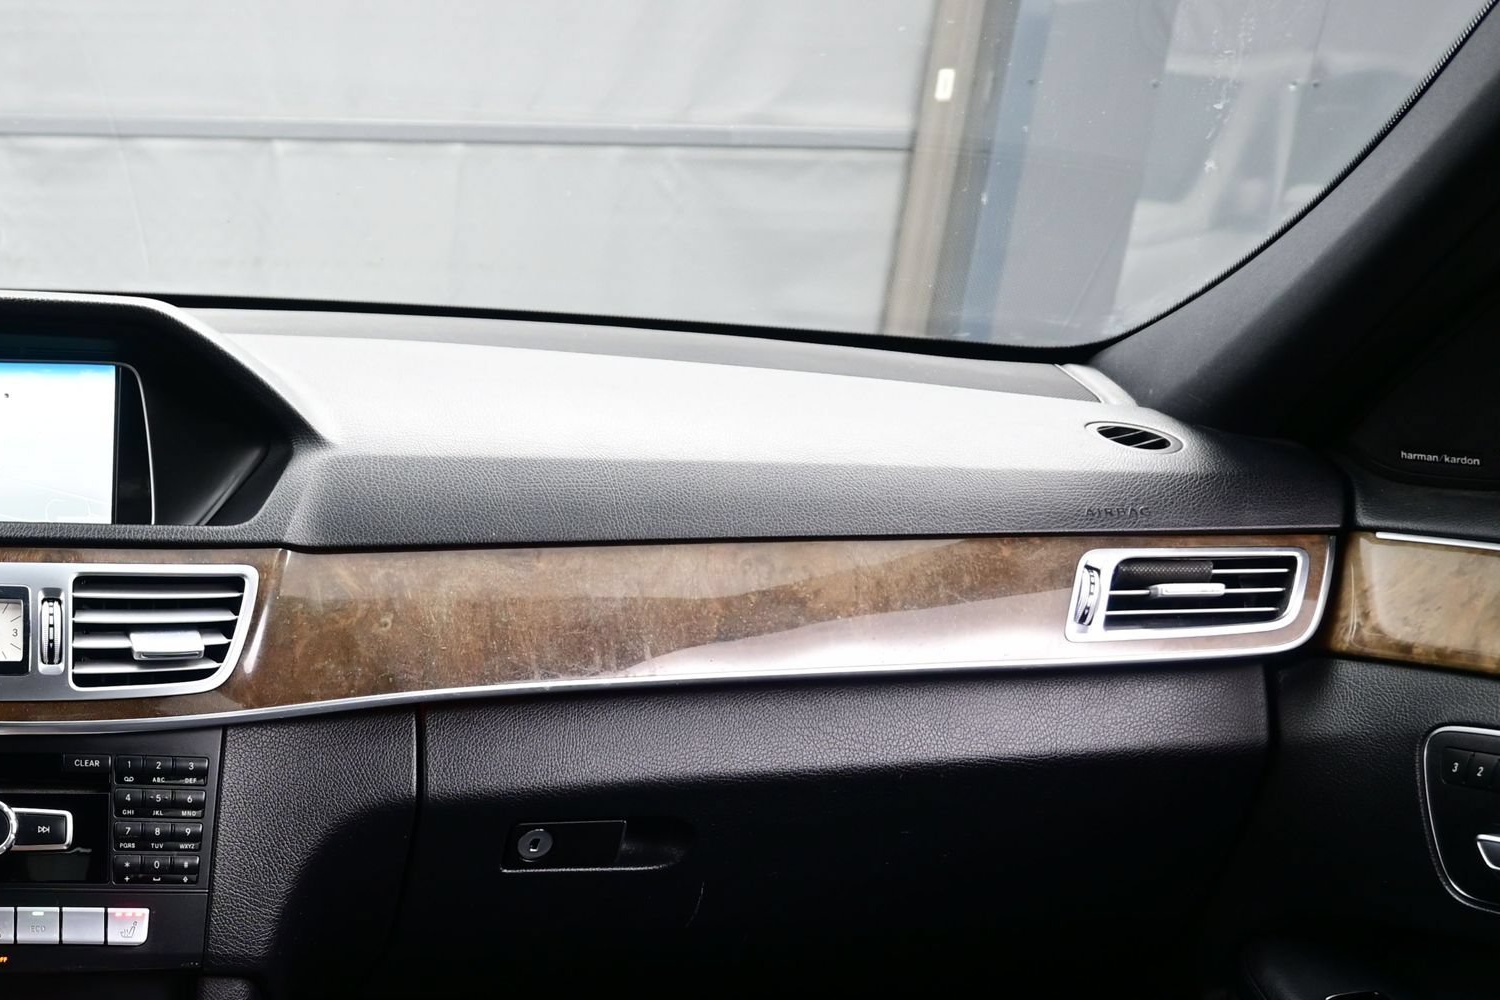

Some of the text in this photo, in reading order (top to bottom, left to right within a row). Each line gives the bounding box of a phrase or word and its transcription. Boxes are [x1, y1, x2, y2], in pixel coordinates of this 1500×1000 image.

[1401, 451, 1480, 465] harman/kardon
[12, 628, 18, 637] 3
[74, 759, 100, 767] CLEAR
[156, 762, 162, 770] 2
[188, 762, 194, 770] 3
[1452, 762, 1459, 773] 3
[1476, 766, 1484, 777] 2
[125, 793, 131, 802] 4
[156, 794, 161, 803] 5
[187, 795, 193, 803] 6
[125, 827, 131, 835] 7
[154, 827, 160, 836] 8
[185, 827, 191, 836] 9
[154, 860, 160, 869] 0
